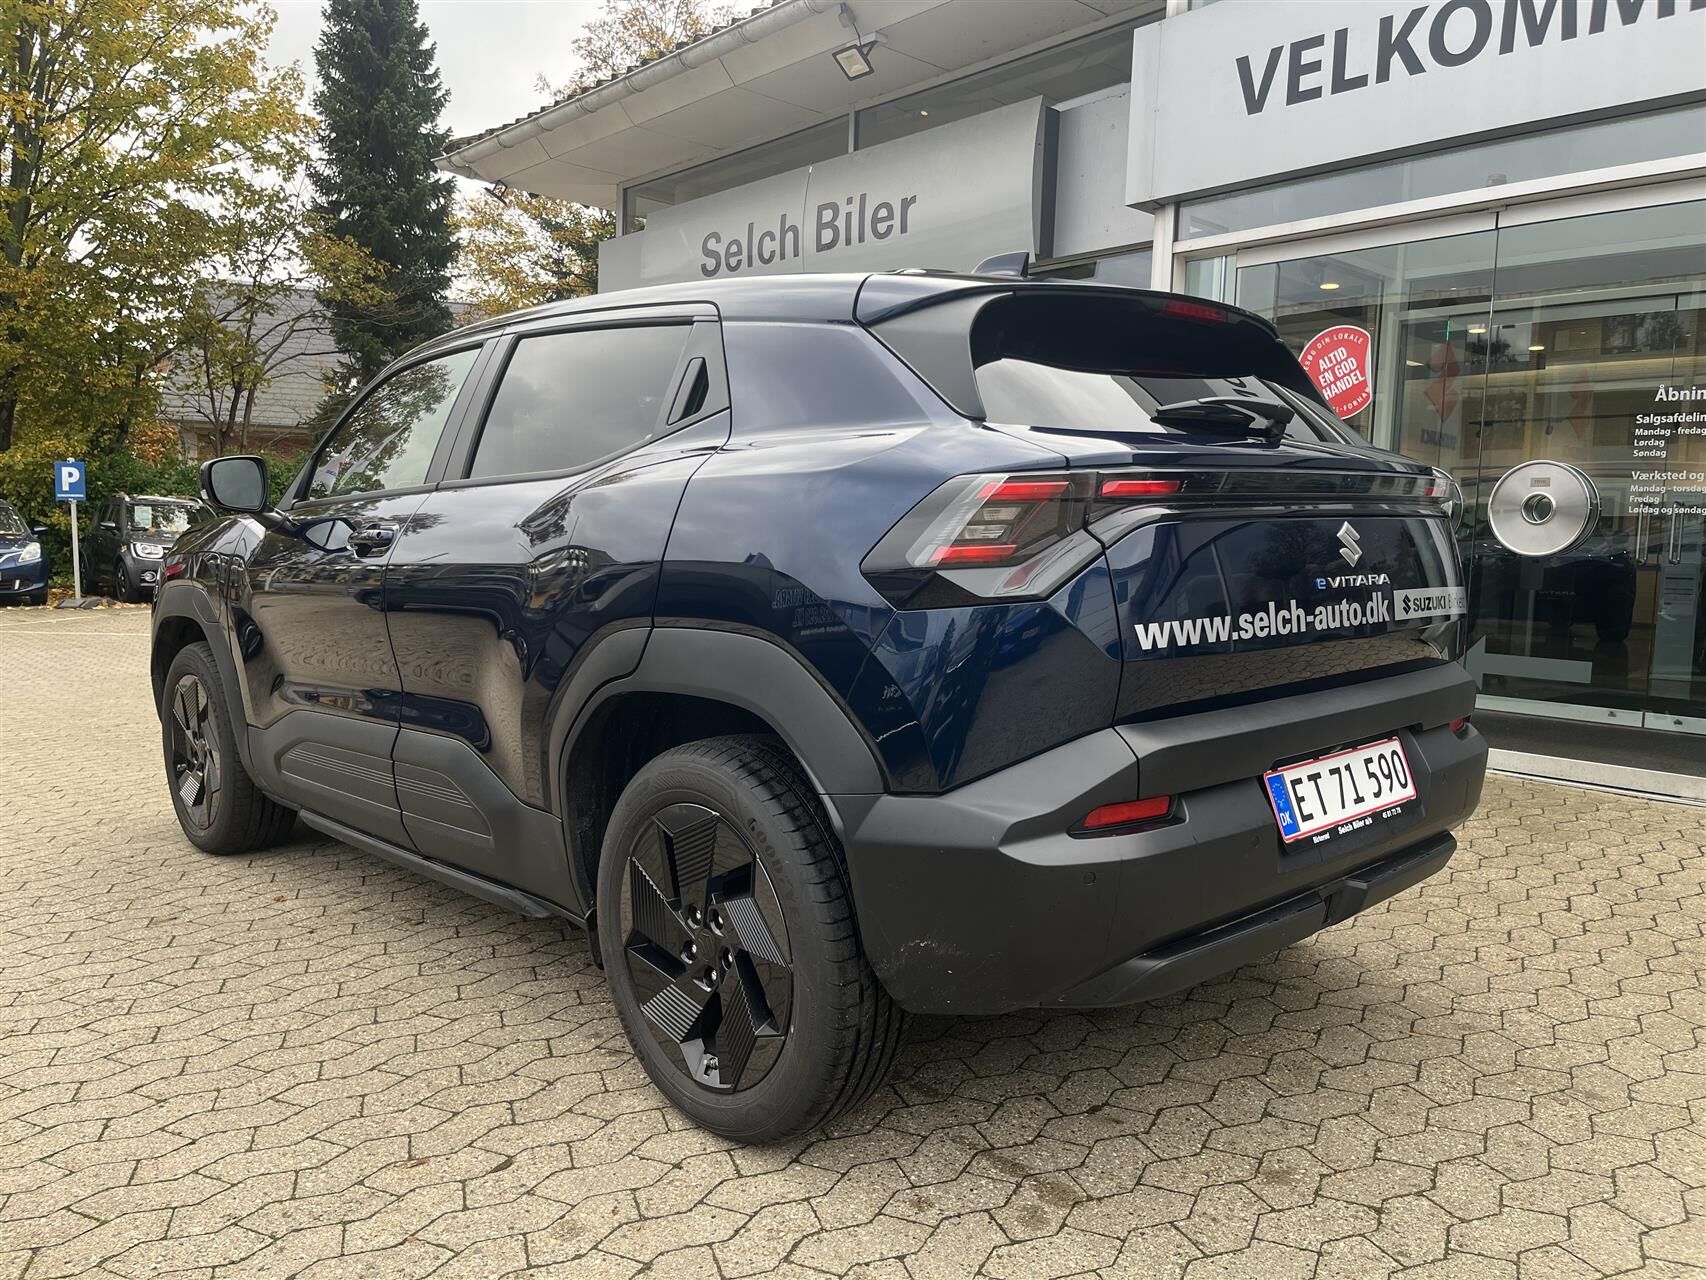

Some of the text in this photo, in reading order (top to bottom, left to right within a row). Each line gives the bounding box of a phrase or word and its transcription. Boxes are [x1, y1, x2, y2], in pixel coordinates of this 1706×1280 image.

[1236, 0, 1706, 116] VELKOM
[701, 192, 917, 278] Selch Biler
[1316, 336, 1330, 349] DIN
[1333, 332, 1364, 345] LOKALE
[1318, 346, 1348, 373] ALTID
[1318, 357, 1358, 387] EN GOD
[1322, 370, 1366, 400] HANDEL
[1634, 428, 1671, 437] Mandag
[1633, 438, 1665, 448] Lørdag
[1632, 449, 1667, 459] Søndag
[61, 466, 80, 491] P
[1631, 470, 1705, 482] Værksted og
[1630, 484, 1666, 494] Mandag
[1629, 495, 1660, 505] Fredag
[1660, 507, 1673, 516] og
[1412, 596, 1446, 612] SUZUKI
[1134, 591, 1391, 651] www.selch-auto.dk
[1290, 749, 1408, 823] ET 71 590
[1280, 812, 1293, 826] DK
[1338, 824, 1353, 834] Selch
